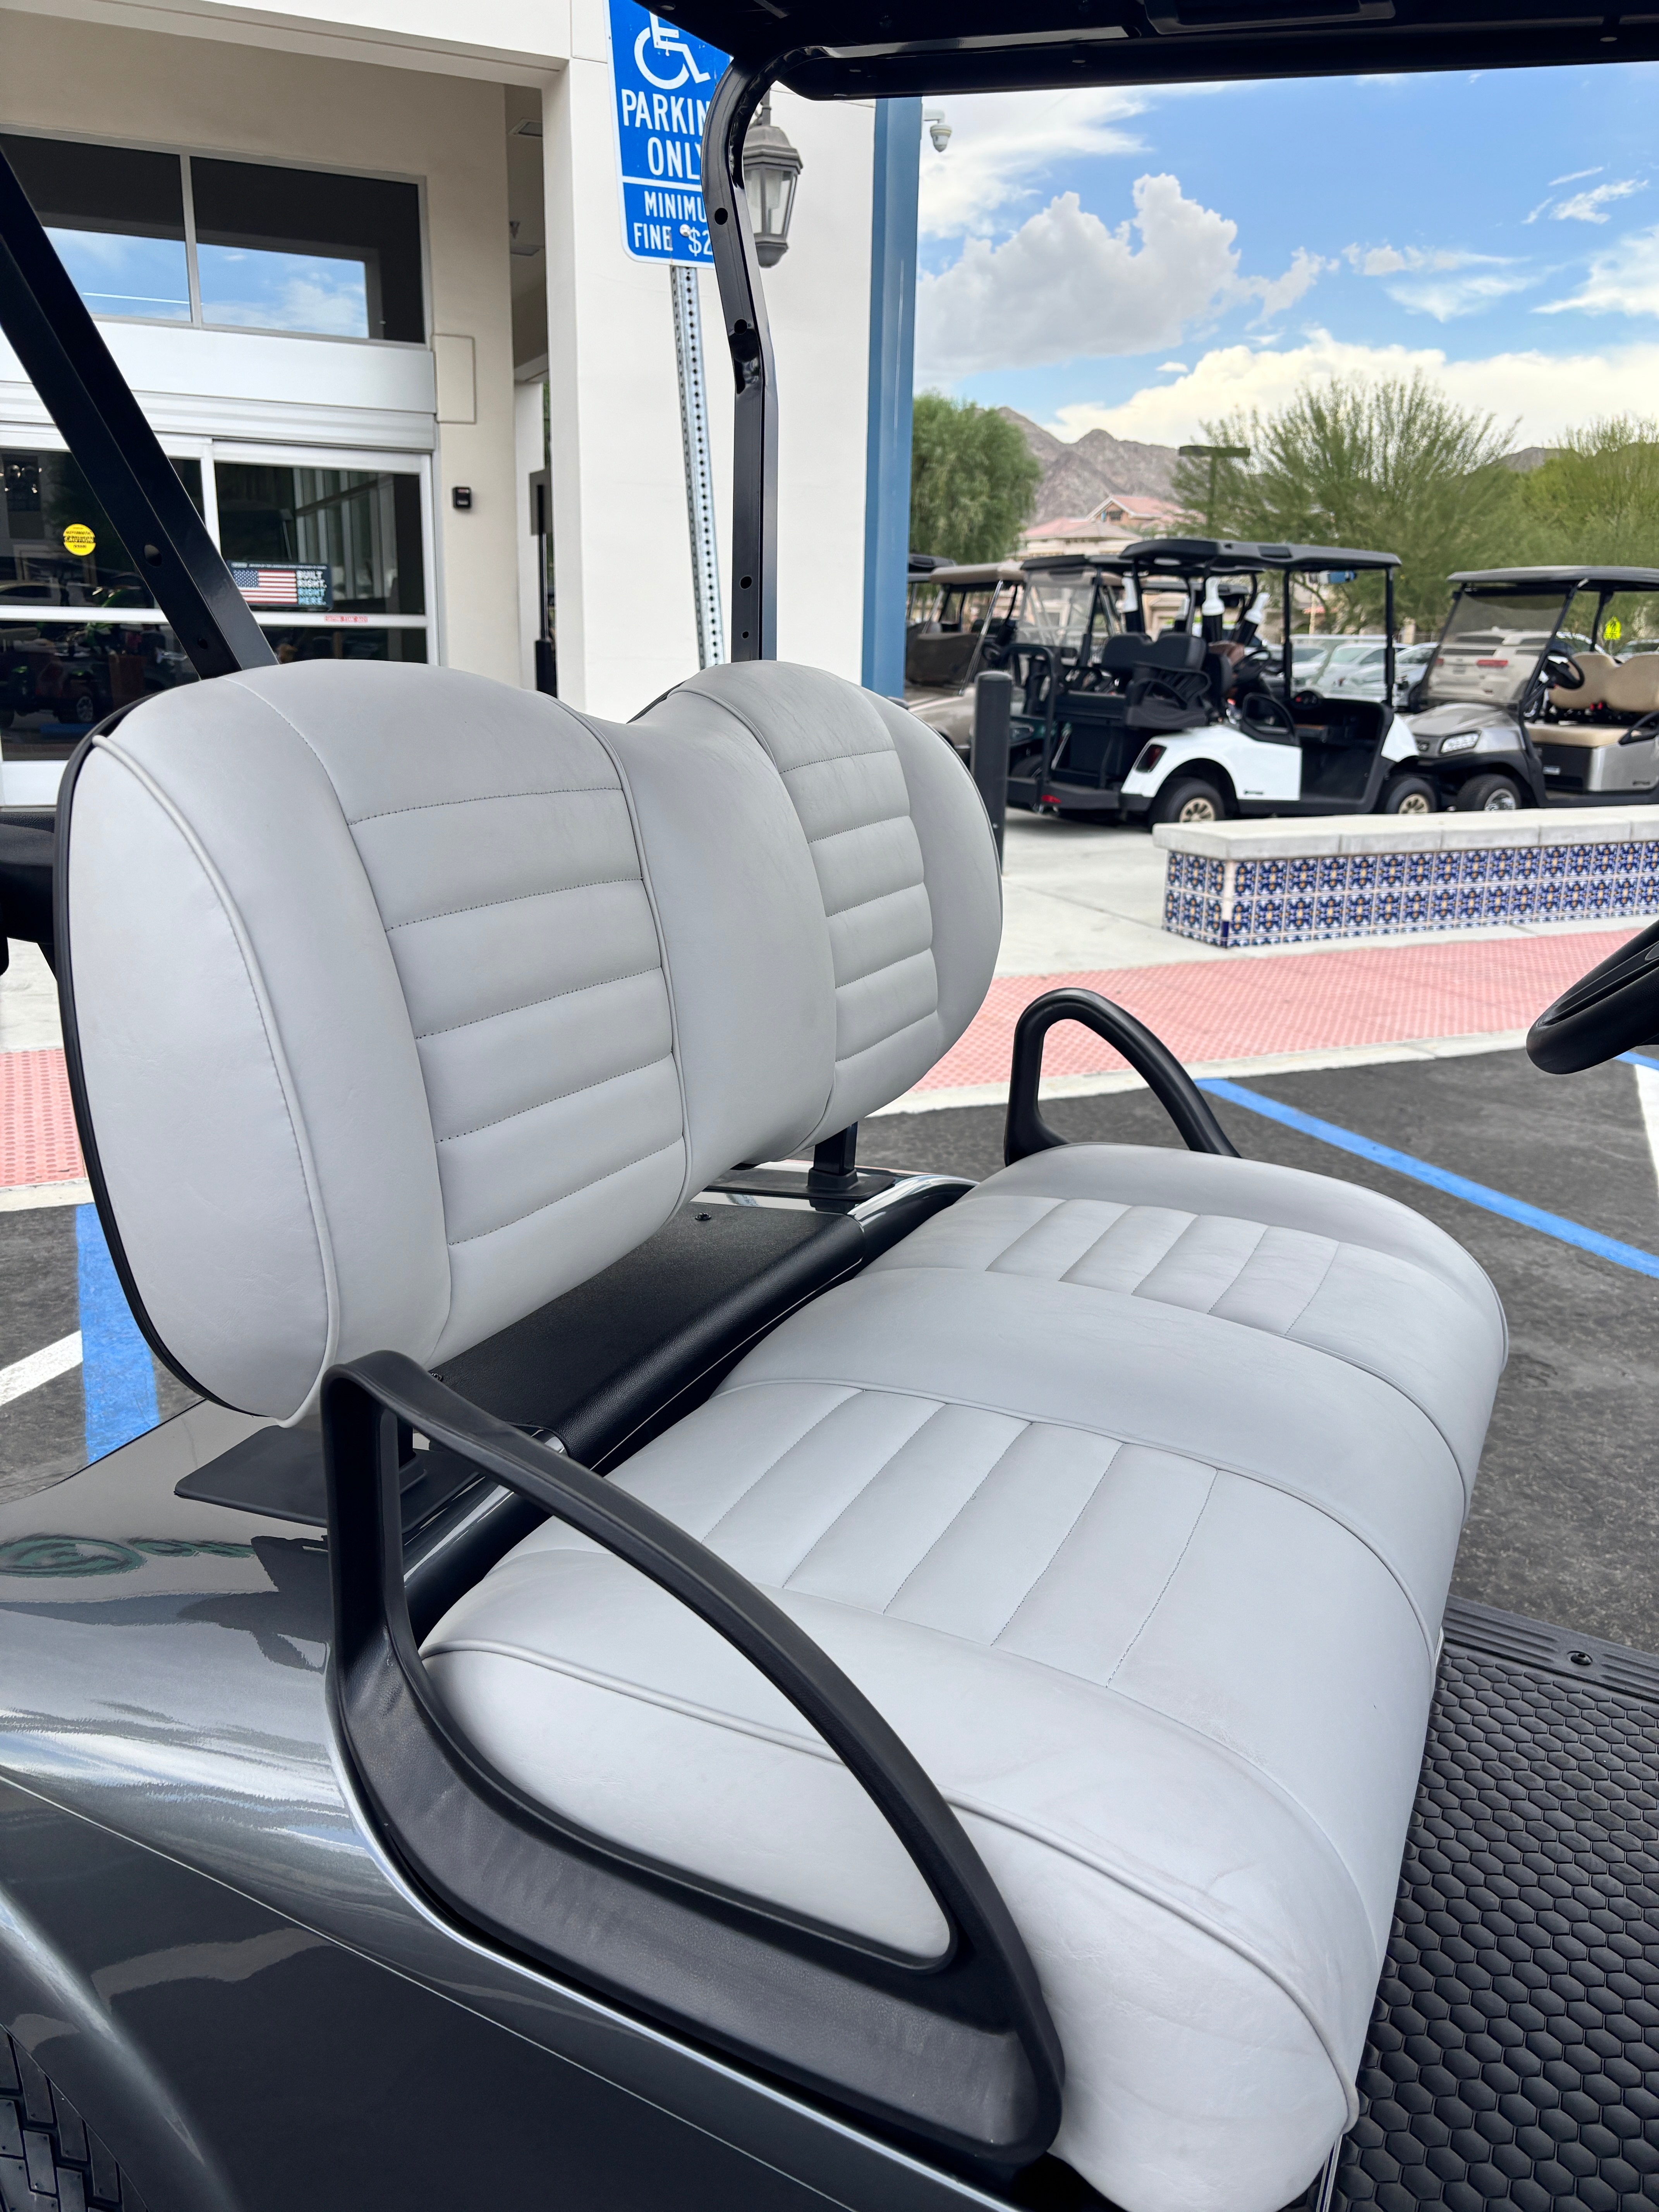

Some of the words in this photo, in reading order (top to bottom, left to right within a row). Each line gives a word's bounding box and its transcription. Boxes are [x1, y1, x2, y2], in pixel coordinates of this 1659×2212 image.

[621, 89, 710, 136] PARKIN
[644, 191, 707, 223] MINIMU
[634, 222, 673, 251] FINE
[297, 570, 323, 580] BUILT
[297, 588, 326, 597] RIGHT
